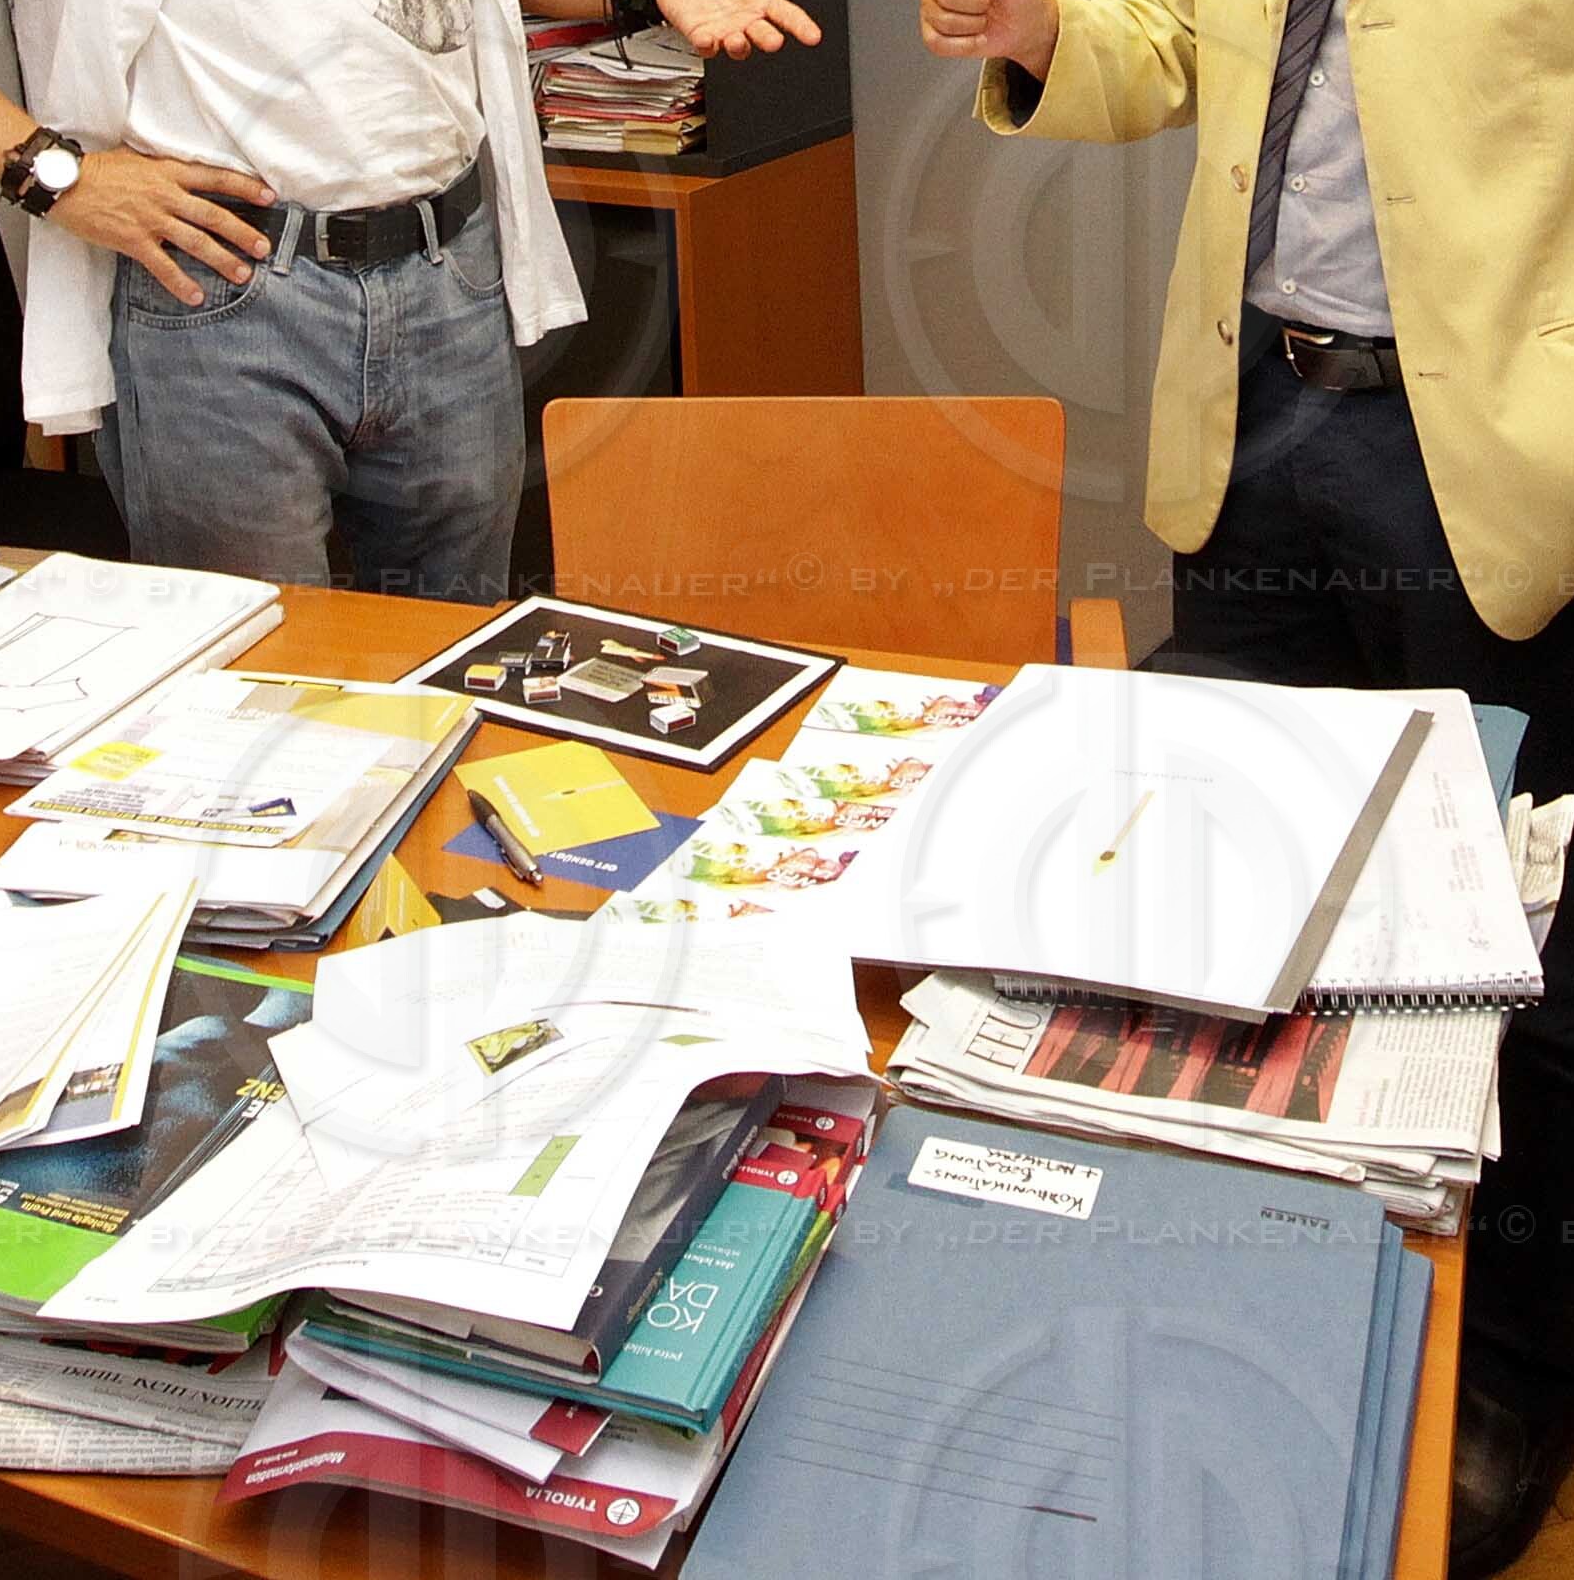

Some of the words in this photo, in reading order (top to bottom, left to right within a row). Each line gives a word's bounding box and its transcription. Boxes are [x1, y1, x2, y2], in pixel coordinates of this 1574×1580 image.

[594, 860, 618, 872] OFT
[52, 1208, 71, 1221] und
[1259, 1210, 1330, 1231] FALKEN
[668, 1276, 719, 1307] DA
[647, 1302, 707, 1334] KO
[654, 1347, 683, 1362] petra
[245, 1450, 347, 1485] Medieninformation
[525, 1485, 597, 1512] TYROLIA
